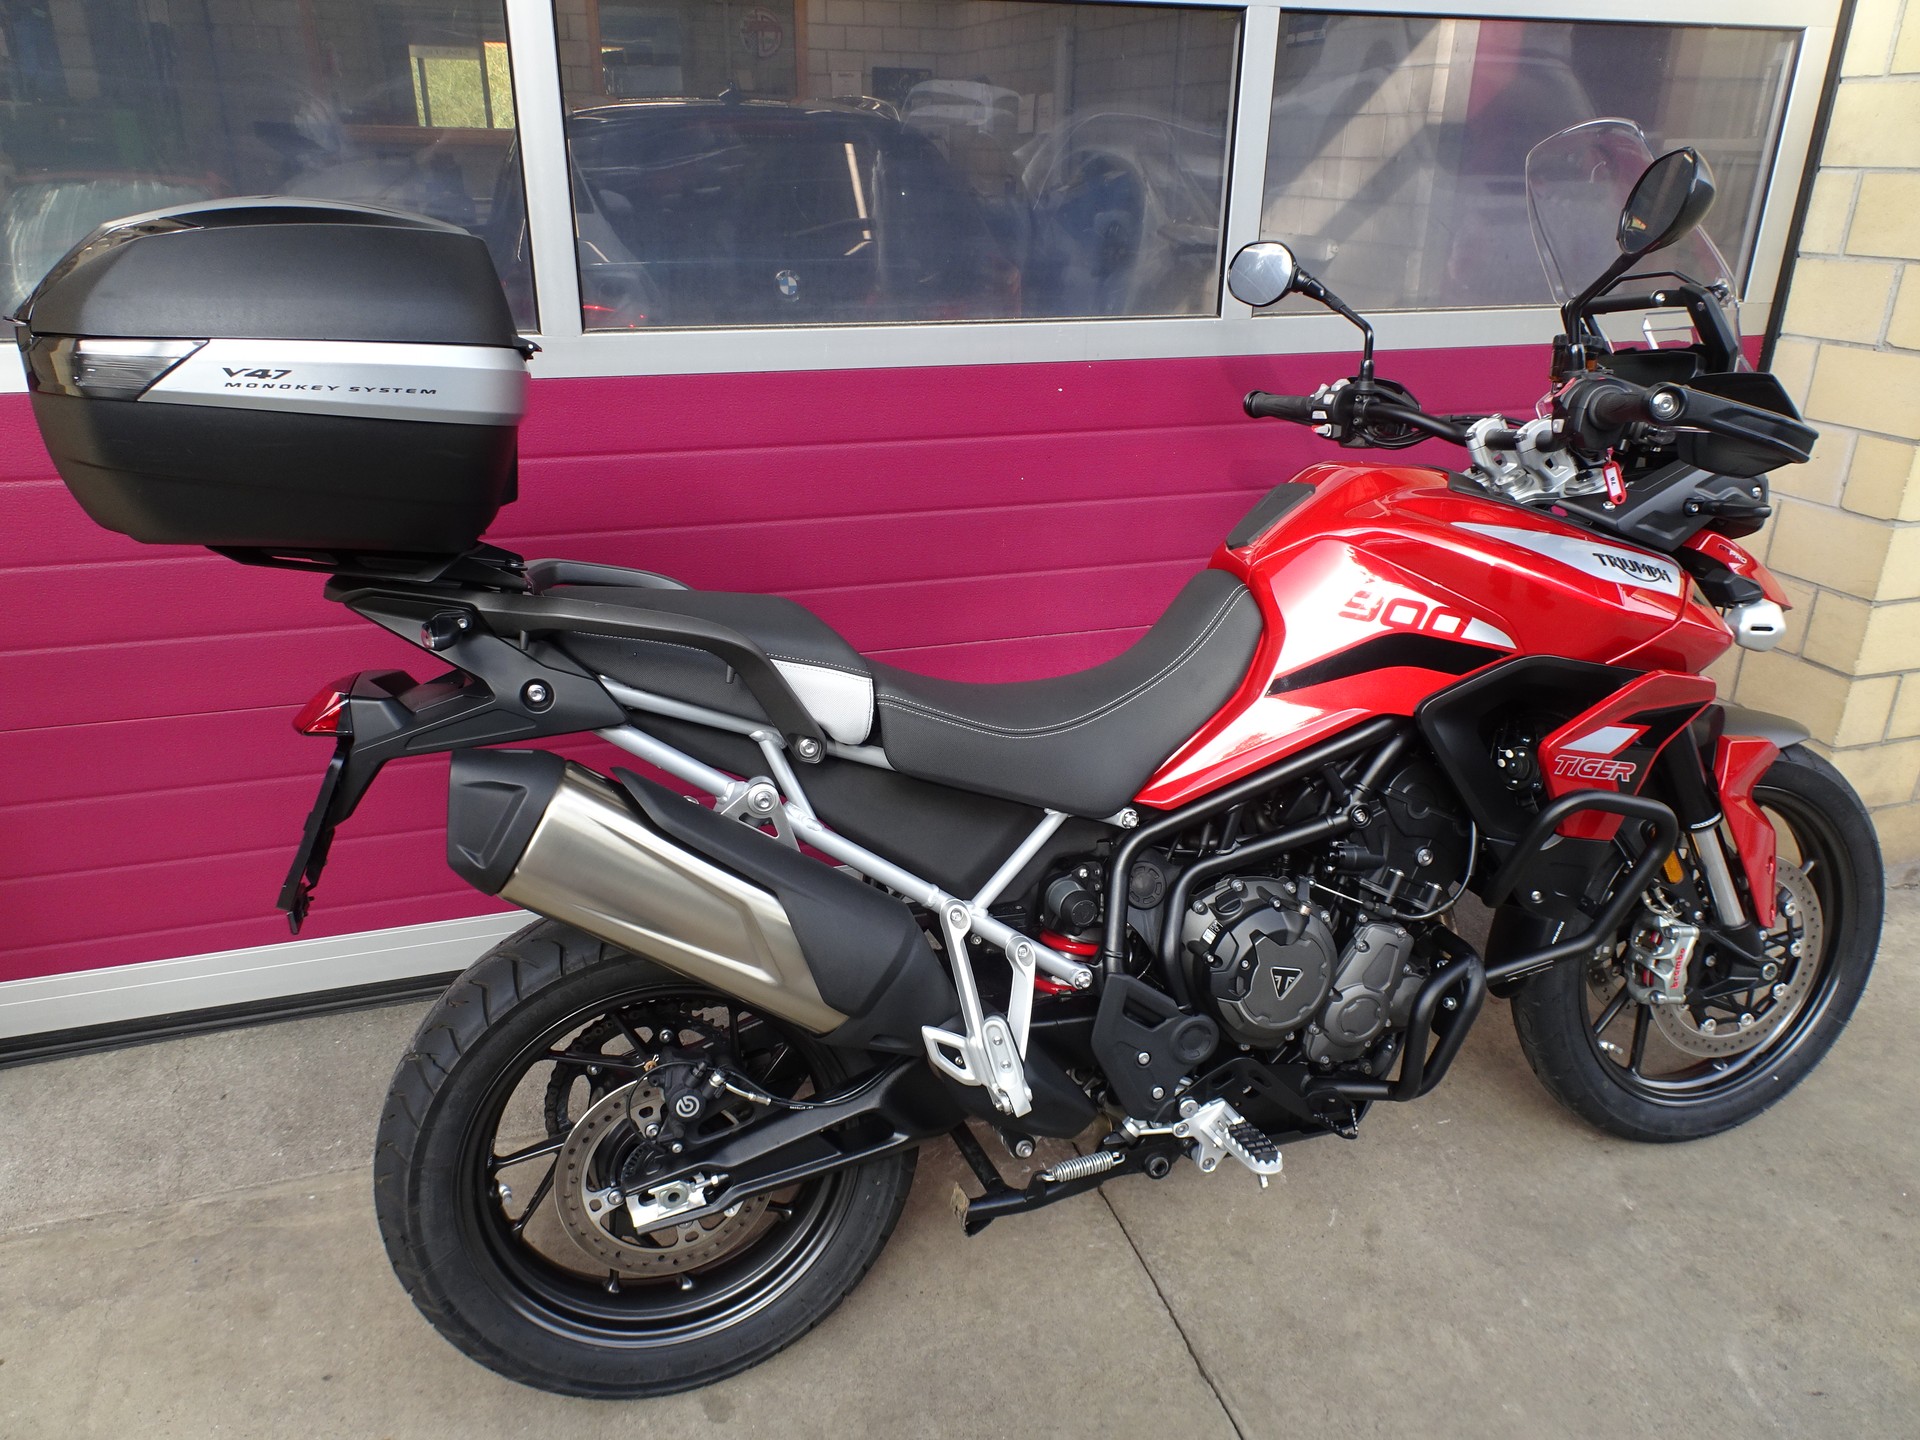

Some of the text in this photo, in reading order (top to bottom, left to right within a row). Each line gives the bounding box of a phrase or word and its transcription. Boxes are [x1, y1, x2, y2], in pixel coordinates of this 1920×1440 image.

[222, 367, 293, 380] V47
[224, 382, 437, 395] MONOKEY SYSTEM
[1592, 552, 1673, 583] TRIUMPH
[1729, 549, 1748, 564] PRO
[1338, 590, 1473, 638] 900
[1554, 754, 1637, 783] TIGER
[1669, 947, 1686, 989] brembo
